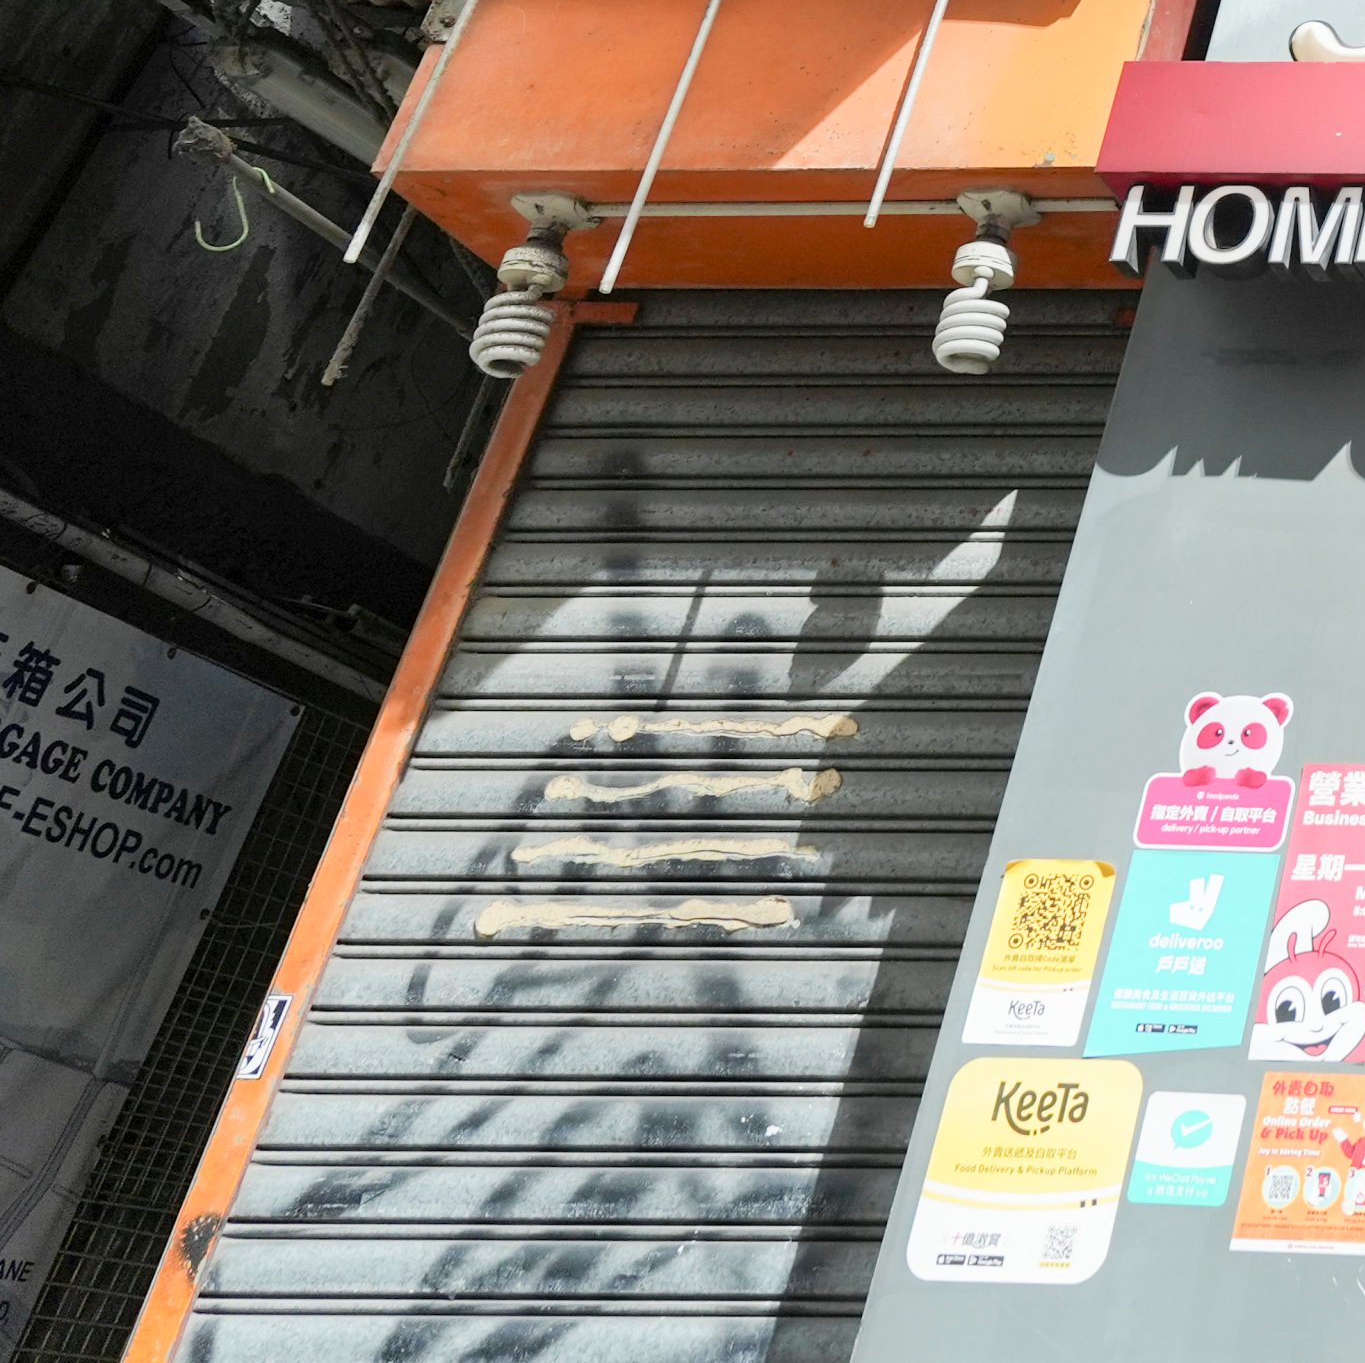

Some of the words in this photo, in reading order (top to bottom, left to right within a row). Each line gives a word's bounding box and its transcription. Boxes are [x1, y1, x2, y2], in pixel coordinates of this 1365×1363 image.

[2, 641, 161, 749] 箱公司
[0, 723, 89, 785] GAGE
[91, 758, 232, 836] COMPANY
[1148, 932, 1224, 951] deliveroo
[1008, 1000, 1045, 1020] KeeTa
[990, 1081, 1090, 1136] KeeTa
[1263, 1115, 1297, 1128] Online
[1298, 1116, 1332, 1128] Order
[1274, 1127, 1305, 1140] Pick
[1308, 1128, 1328, 1144] Up
[954, 1164, 976, 1174] Food
[978, 1164, 1015, 1176] Delivery
[1026, 1165, 1056, 1176] Pickup
[1058, 1166, 1098, 1177] Platform
